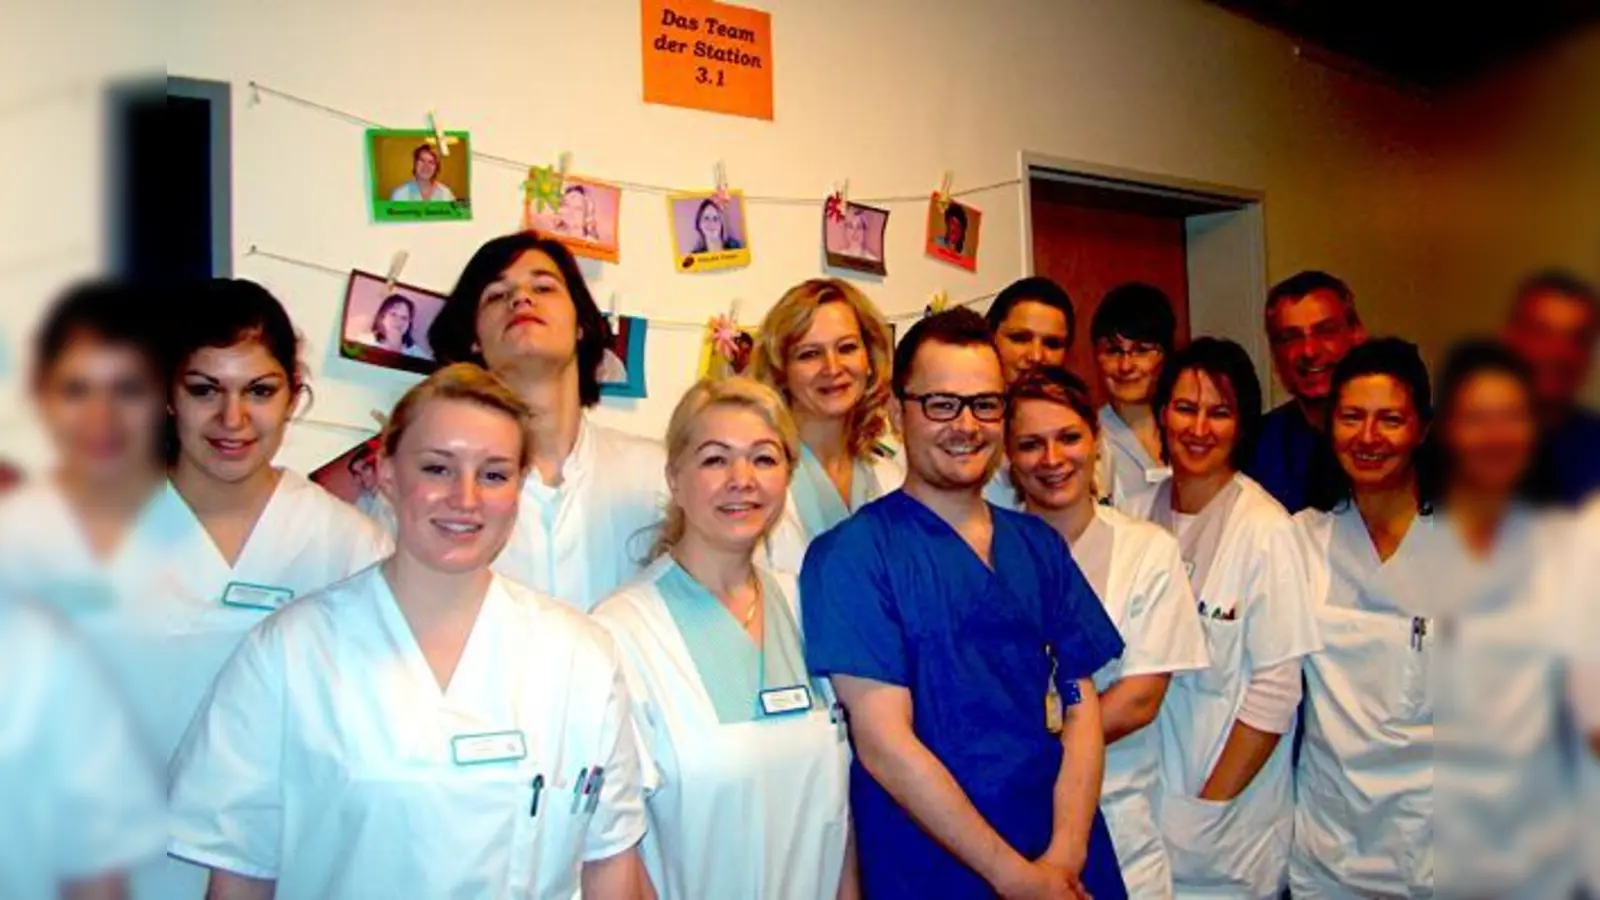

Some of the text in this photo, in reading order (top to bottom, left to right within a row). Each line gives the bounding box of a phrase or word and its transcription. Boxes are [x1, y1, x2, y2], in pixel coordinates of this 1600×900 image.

[661, 8, 755, 43] Das Team
[654, 33, 762, 69] der Station
[695, 66, 725, 87] 3.1
